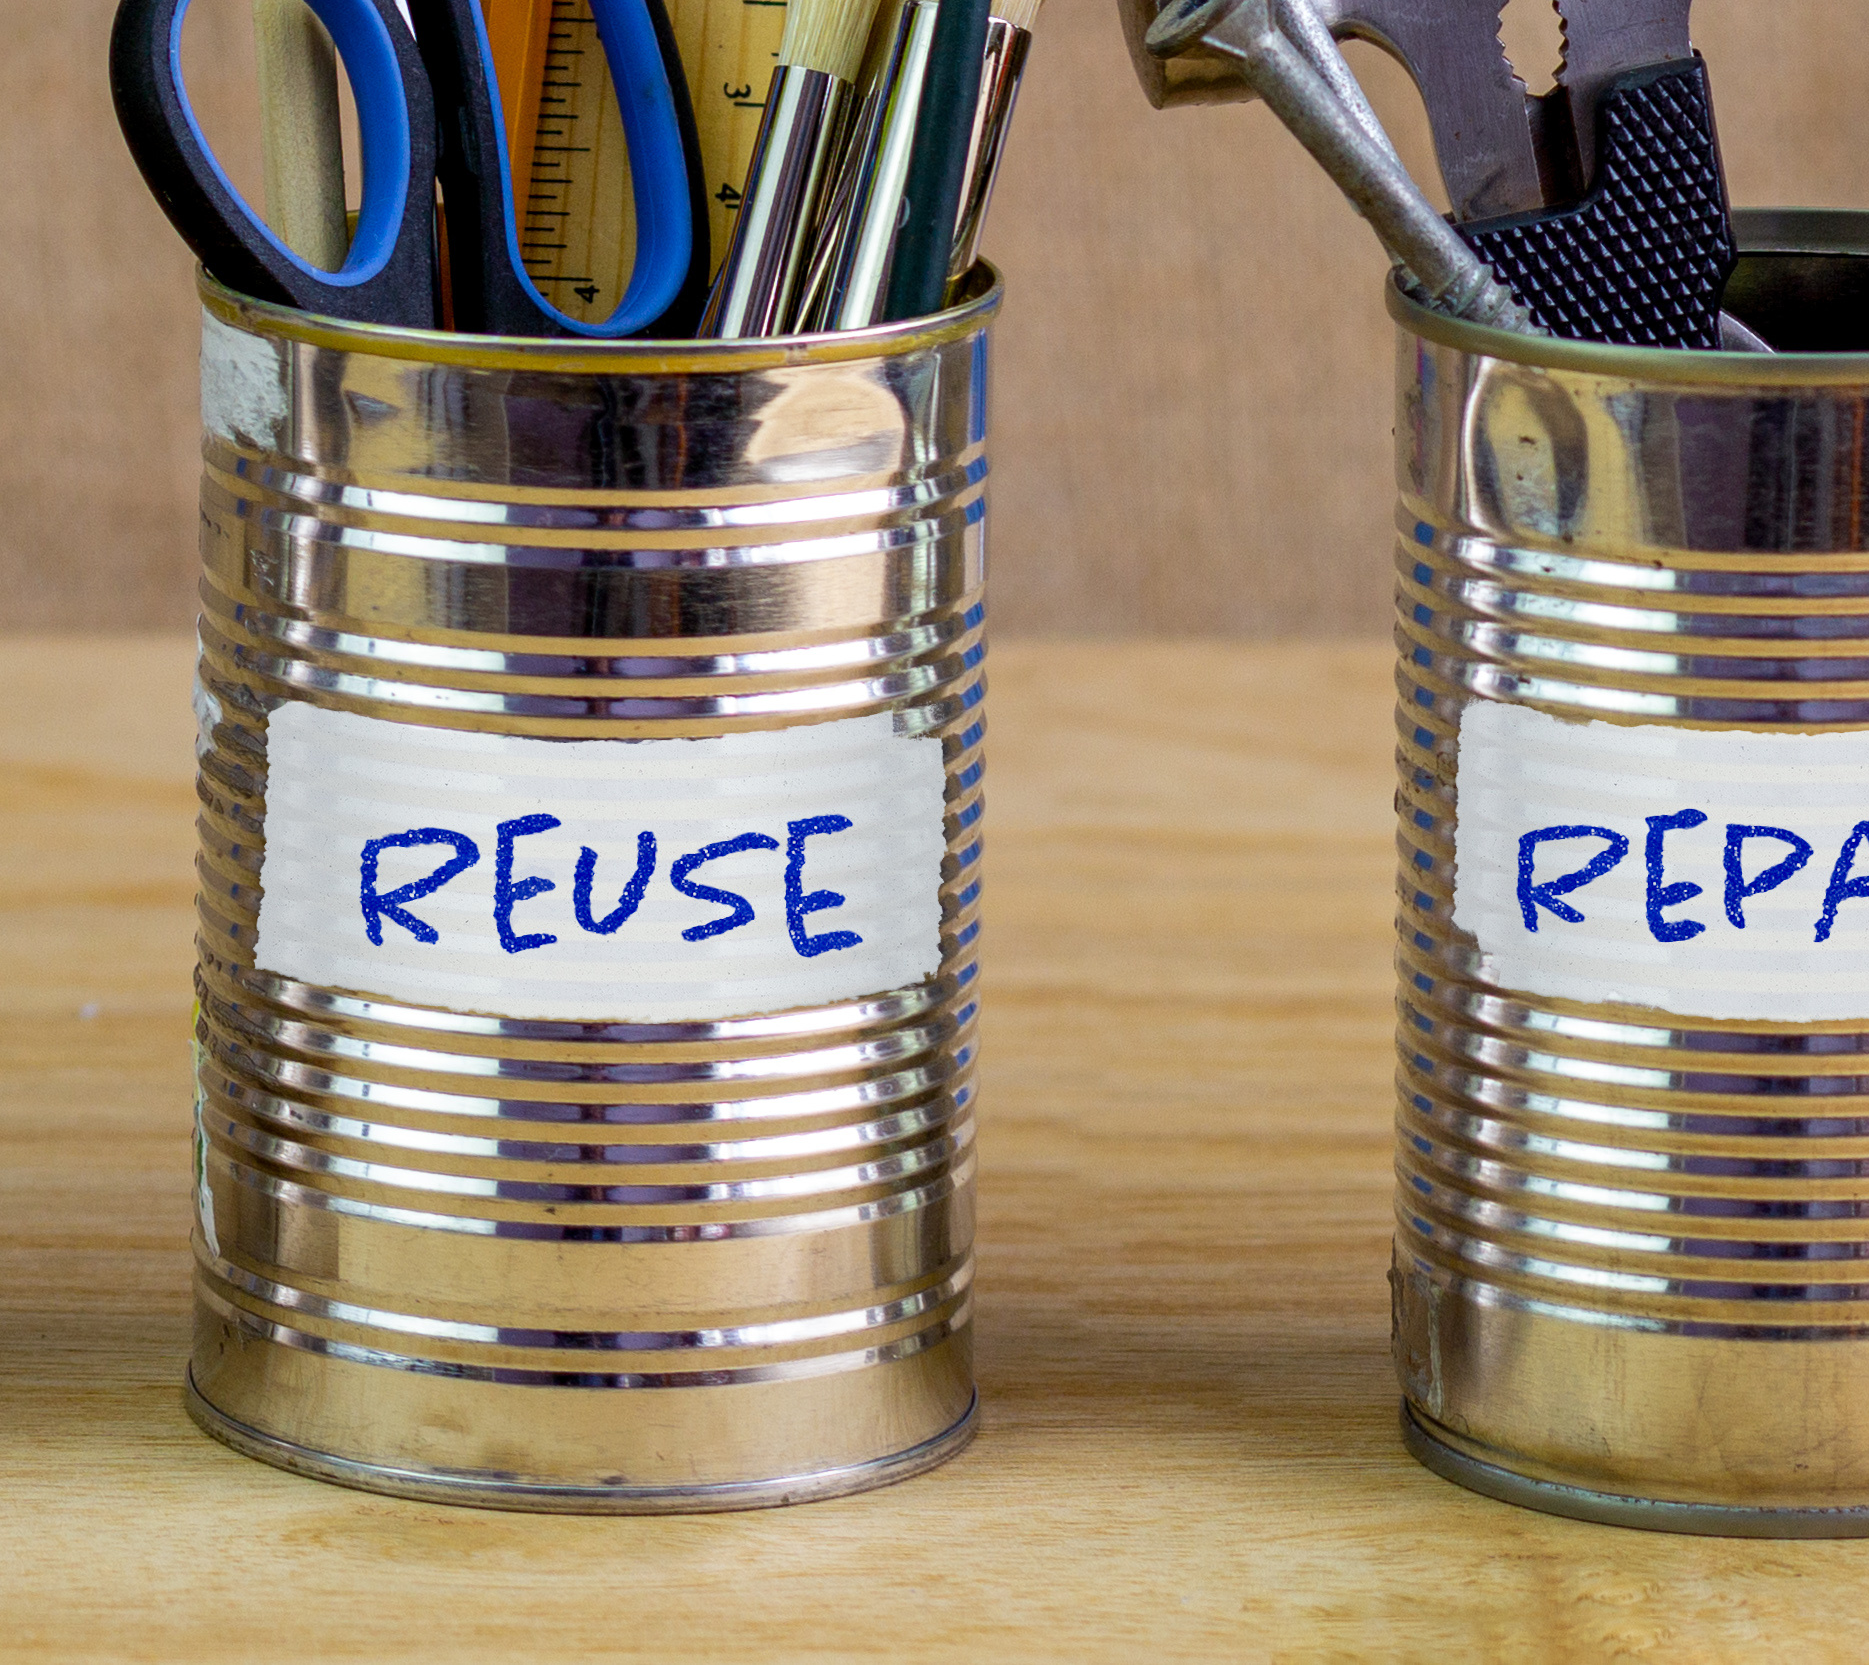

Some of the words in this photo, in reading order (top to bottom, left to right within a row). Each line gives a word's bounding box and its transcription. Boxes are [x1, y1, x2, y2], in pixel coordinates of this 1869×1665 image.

[723, 82, 751, 99] 3
[714, 183, 742, 202] 4
[573, 285, 600, 304] 4
[359, 814, 864, 958] REUSE
